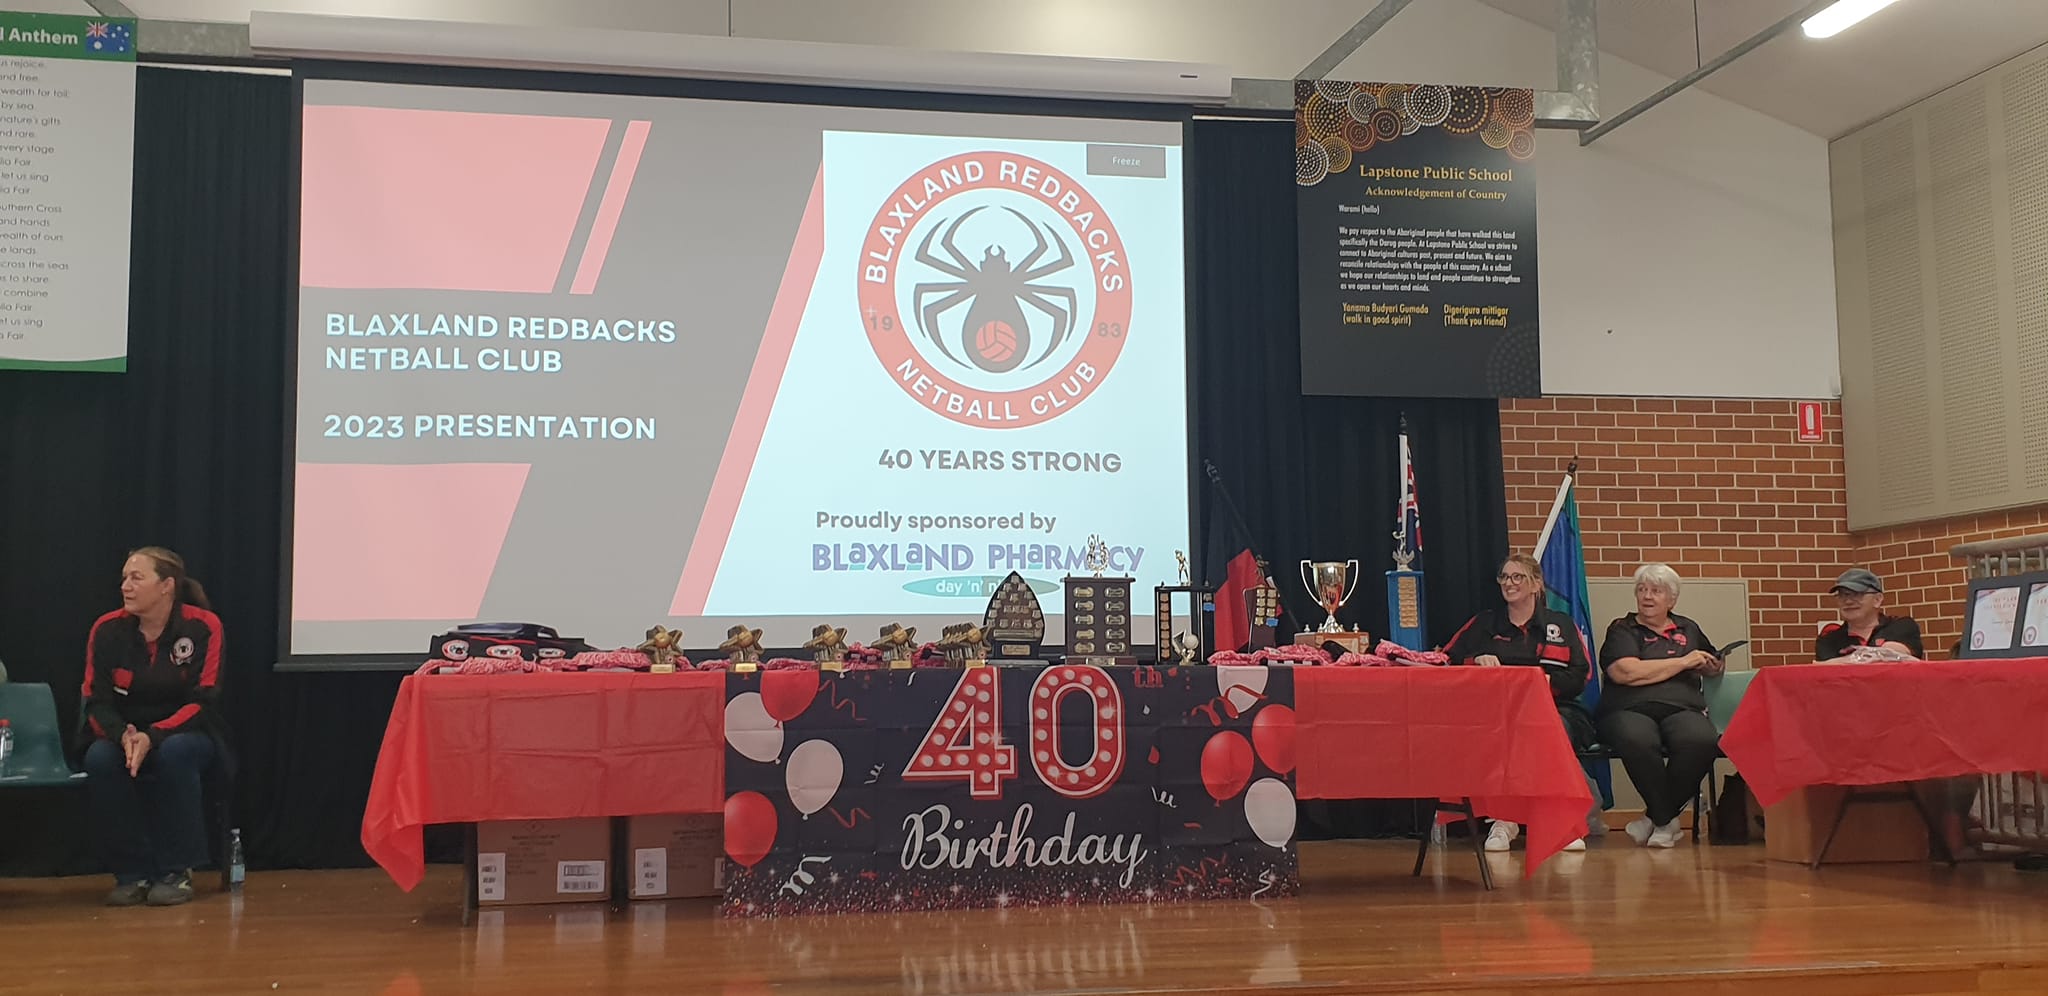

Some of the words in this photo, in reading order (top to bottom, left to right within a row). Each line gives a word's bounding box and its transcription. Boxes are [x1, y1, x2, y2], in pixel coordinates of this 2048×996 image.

[8, 28, 78, 45] Anthem
[1112, 156, 1141, 167] Freeze
[1360, 165, 1419, 181] Lapstone
[1424, 166, 1464, 180] Public
[1468, 168, 1512, 182] School
[1365, 186, 1454, 200] Acknowledgement
[1456, 188, 1466, 198] of
[1469, 189, 1508, 202] Country
[865, 160, 984, 284] BLAXLAND
[999, 160, 1123, 292] REDBACKS
[326, 313, 499, 338] BLAXLAND
[508, 316, 676, 342] REDBACKS
[870, 316, 893, 331] 19
[1098, 322, 1122, 338] 83
[1343, 313, 1362, 325] (walk
[1364, 314, 1371, 324] in
[1372, 314, 1390, 325] good
[1392, 314, 1412, 327] spirit)
[1444, 314, 1468, 327] (Thank
[1470, 318, 1482, 327] you
[1484, 315, 1506, 328] friend)
[326, 347, 469, 370] NETBALL
[477, 348, 562, 372] CLUB
[896, 358, 1019, 420] NETBALL
[1030, 361, 1096, 416] CLUB
[324, 414, 404, 438] 2023
[414, 414, 656, 440] PRESENTATION
[878, 448, 912, 470] 40
[920, 450, 1005, 471] YEARS
[1012, 452, 1122, 473] STRONG
[816, 511, 902, 532] Proudly
[908, 512, 1024, 533] sponsored
[1030, 512, 1056, 534] by
[936, 580, 962, 594] day
[902, 664, 1126, 800] 40
[901, 803, 1147, 888] Birthday
